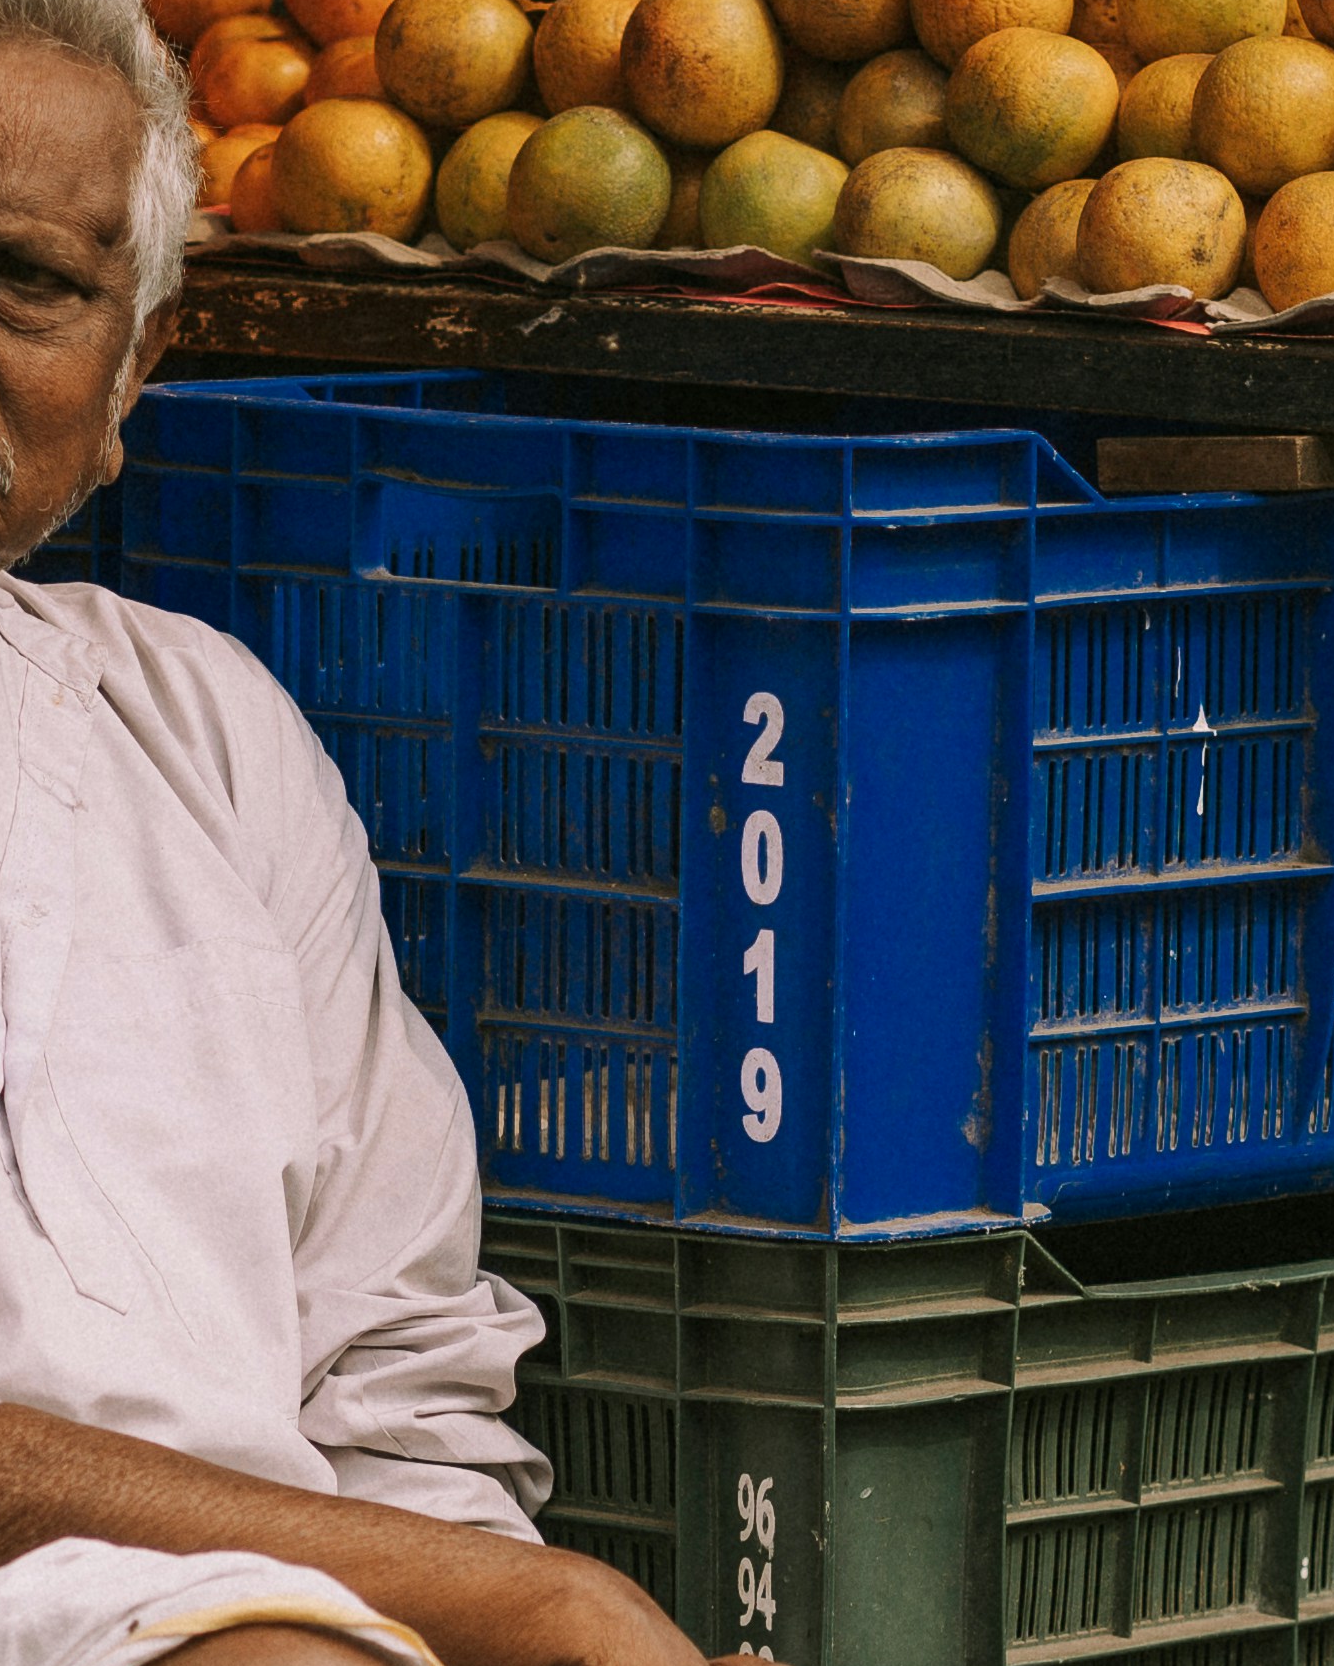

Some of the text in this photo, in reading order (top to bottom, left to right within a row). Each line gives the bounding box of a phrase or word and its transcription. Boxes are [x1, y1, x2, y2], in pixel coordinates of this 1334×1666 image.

[739, 691, 786, 1143] 2019
[737, 1472, 776, 1550] 96
[737, 1556, 777, 1632] 94
